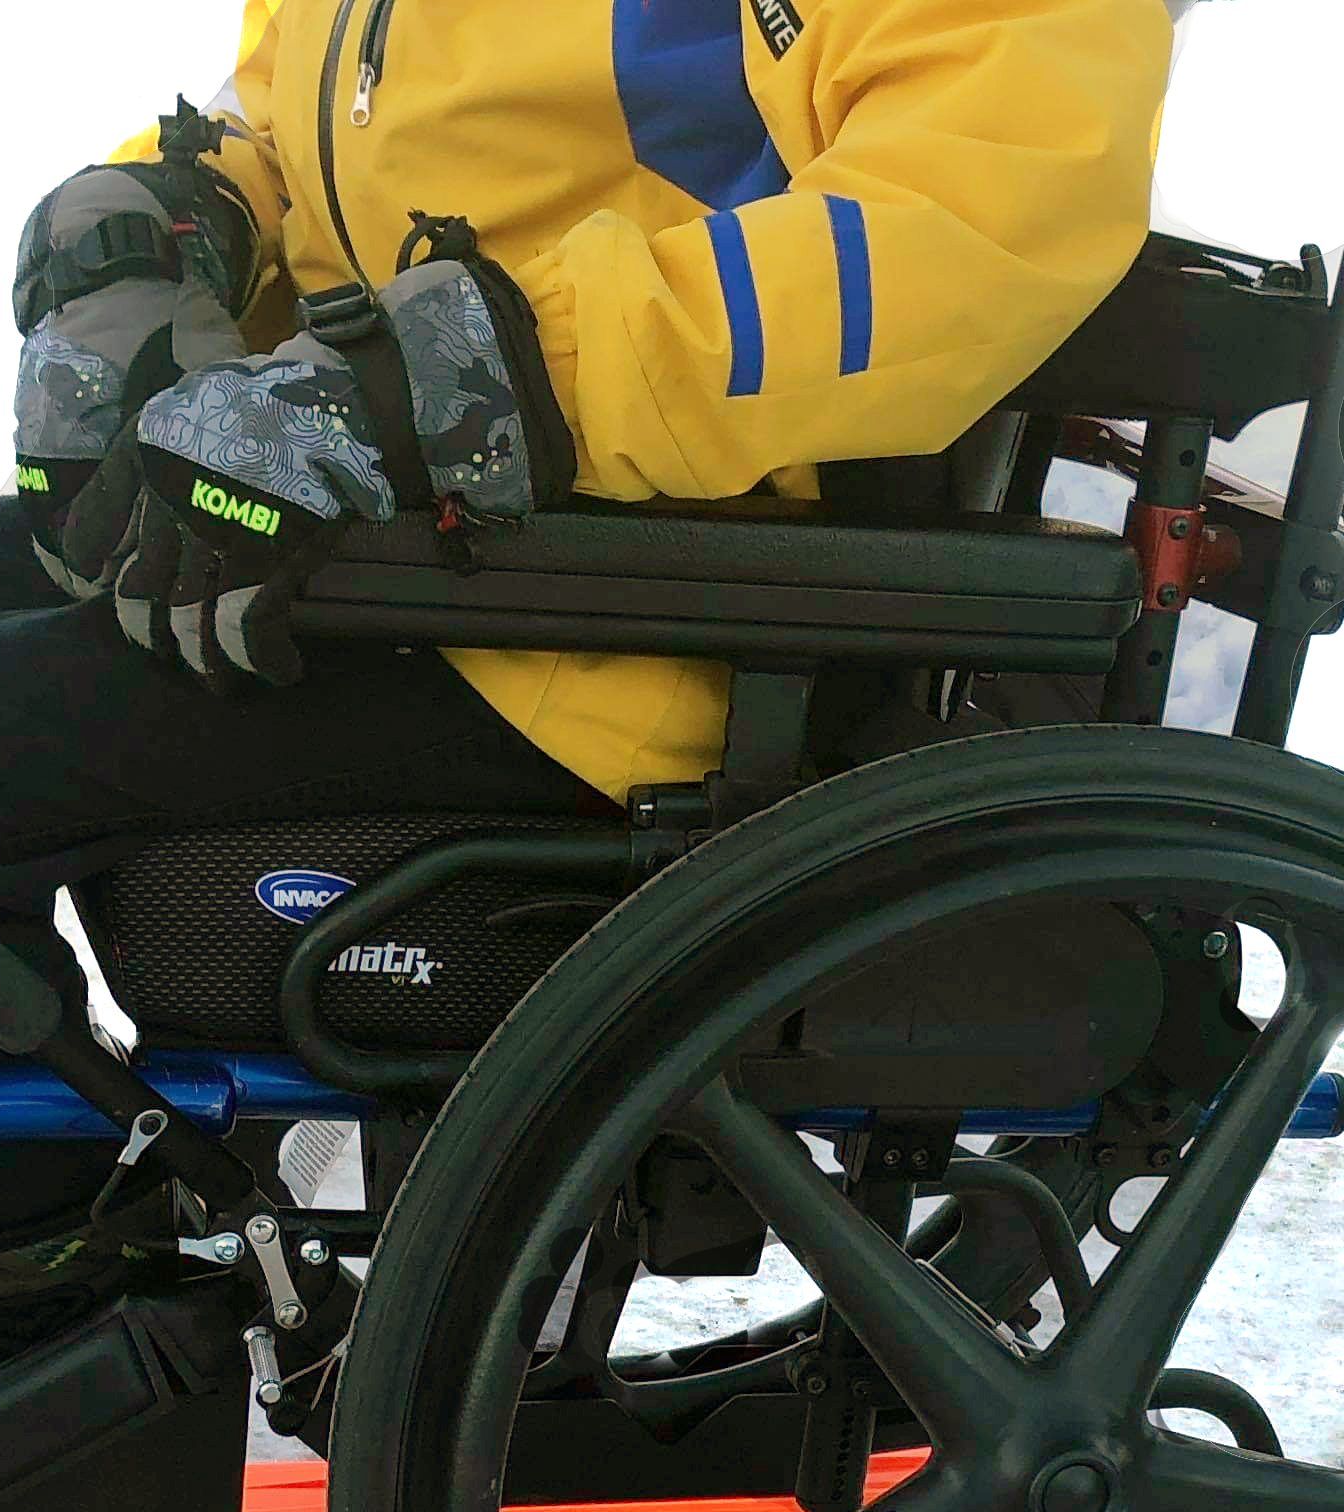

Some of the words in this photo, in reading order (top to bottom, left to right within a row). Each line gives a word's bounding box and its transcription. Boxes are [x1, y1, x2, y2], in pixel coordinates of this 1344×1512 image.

[757, 0, 797, 51] NTE
[191, 479, 281, 536] KOMBI
[273, 889, 344, 908] INVAC
